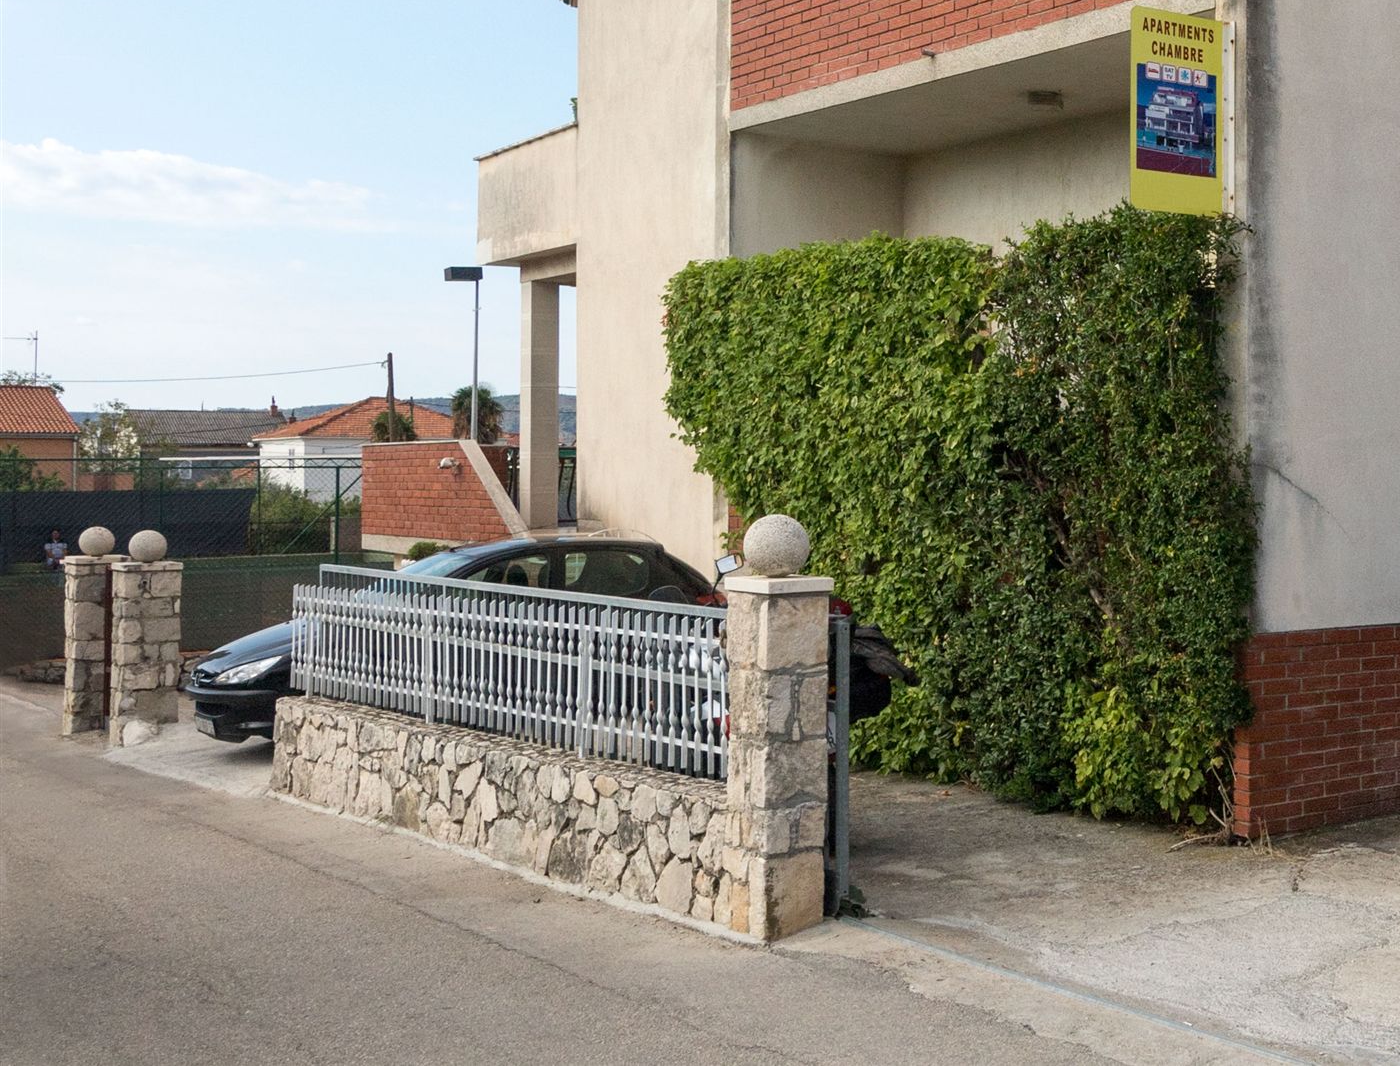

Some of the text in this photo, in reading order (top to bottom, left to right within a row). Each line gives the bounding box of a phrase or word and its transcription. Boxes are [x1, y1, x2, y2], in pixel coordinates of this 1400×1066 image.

[1142, 17, 1214, 44] APARTMENTS
[1152, 40, 1203, 63] CHAMBRE
[1164, 66, 1175, 74] SAT
